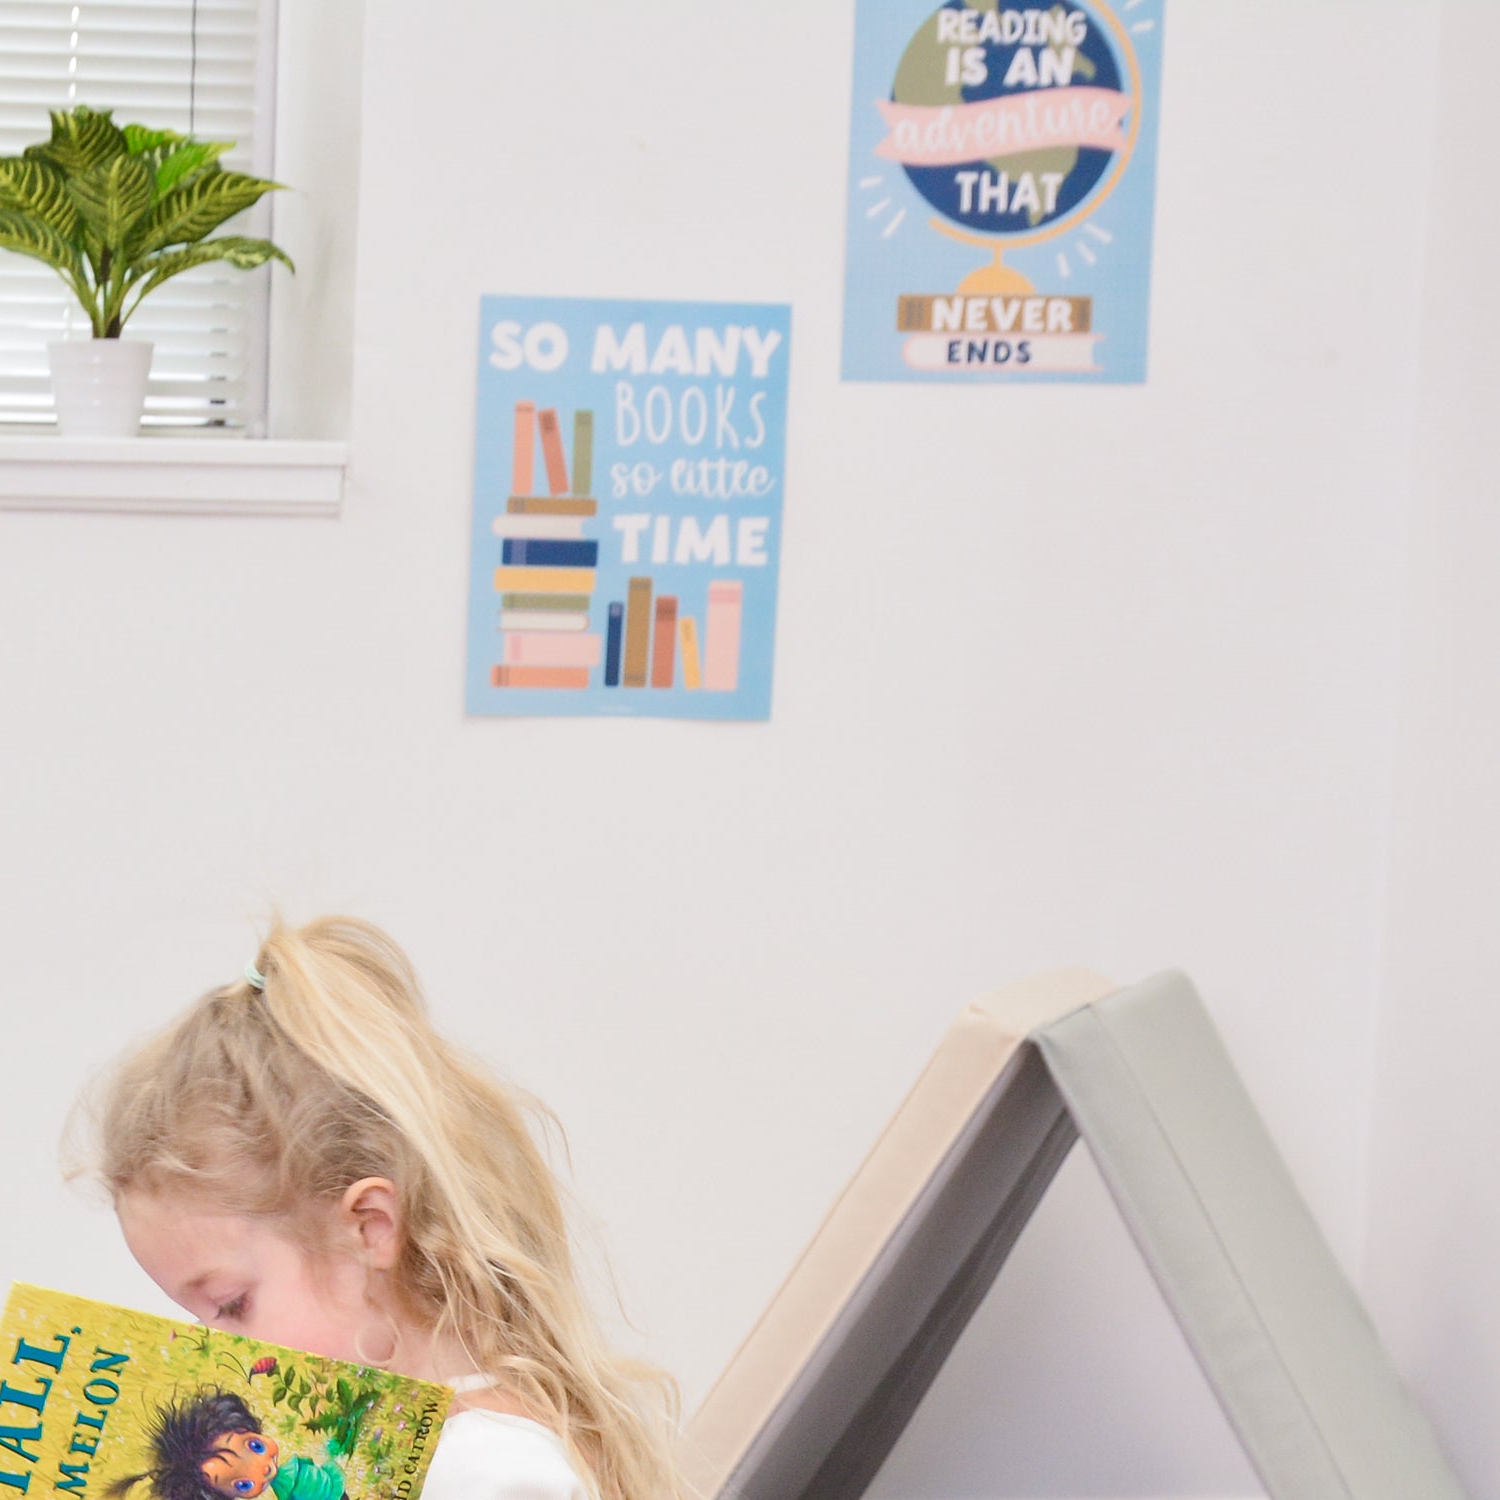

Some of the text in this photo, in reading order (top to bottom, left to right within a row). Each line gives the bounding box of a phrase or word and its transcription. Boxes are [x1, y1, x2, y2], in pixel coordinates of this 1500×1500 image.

[937, 9, 1087, 44] READING
[945, 48, 1075, 86] IS AN
[894, 96, 1114, 156] adventure
[955, 172, 1064, 213] THAT
[931, 298, 1074, 331] NEVER
[489, 320, 782, 378] SO MANY
[946, 340, 1032, 364] ENDS
[614, 380, 767, 449] BOOKS
[609, 457, 775, 500] so little
[612, 513, 769, 566] TIME
[53, 1346, 131, 1499] MELON
[404, 1399, 439, 1475] CATROW
